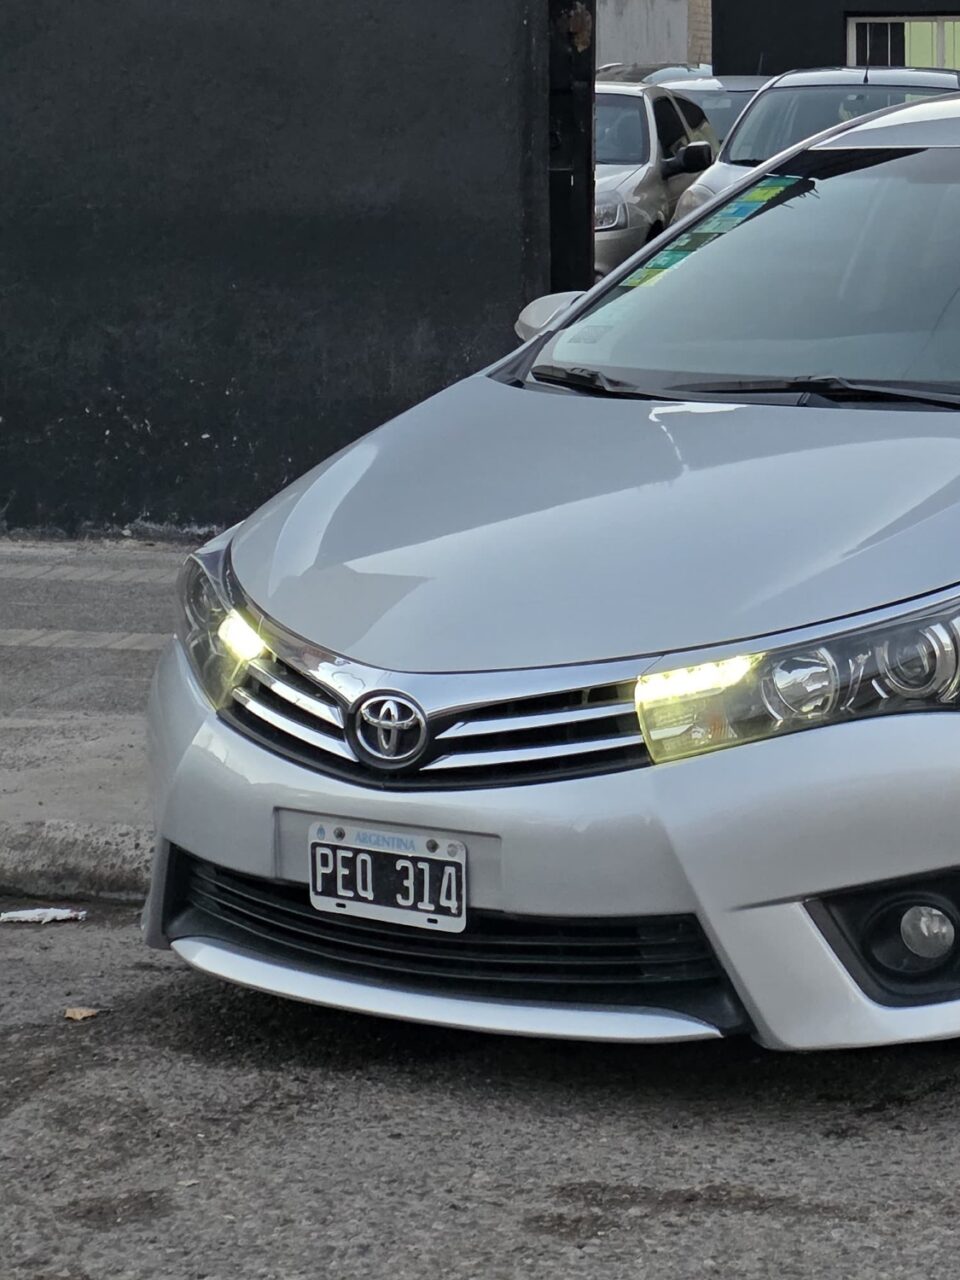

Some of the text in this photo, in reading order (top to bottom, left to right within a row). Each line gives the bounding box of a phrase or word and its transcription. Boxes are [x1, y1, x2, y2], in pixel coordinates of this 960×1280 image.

[355, 831, 416, 852] ARGENTINA
[315, 847, 459, 914] PEQ 314
